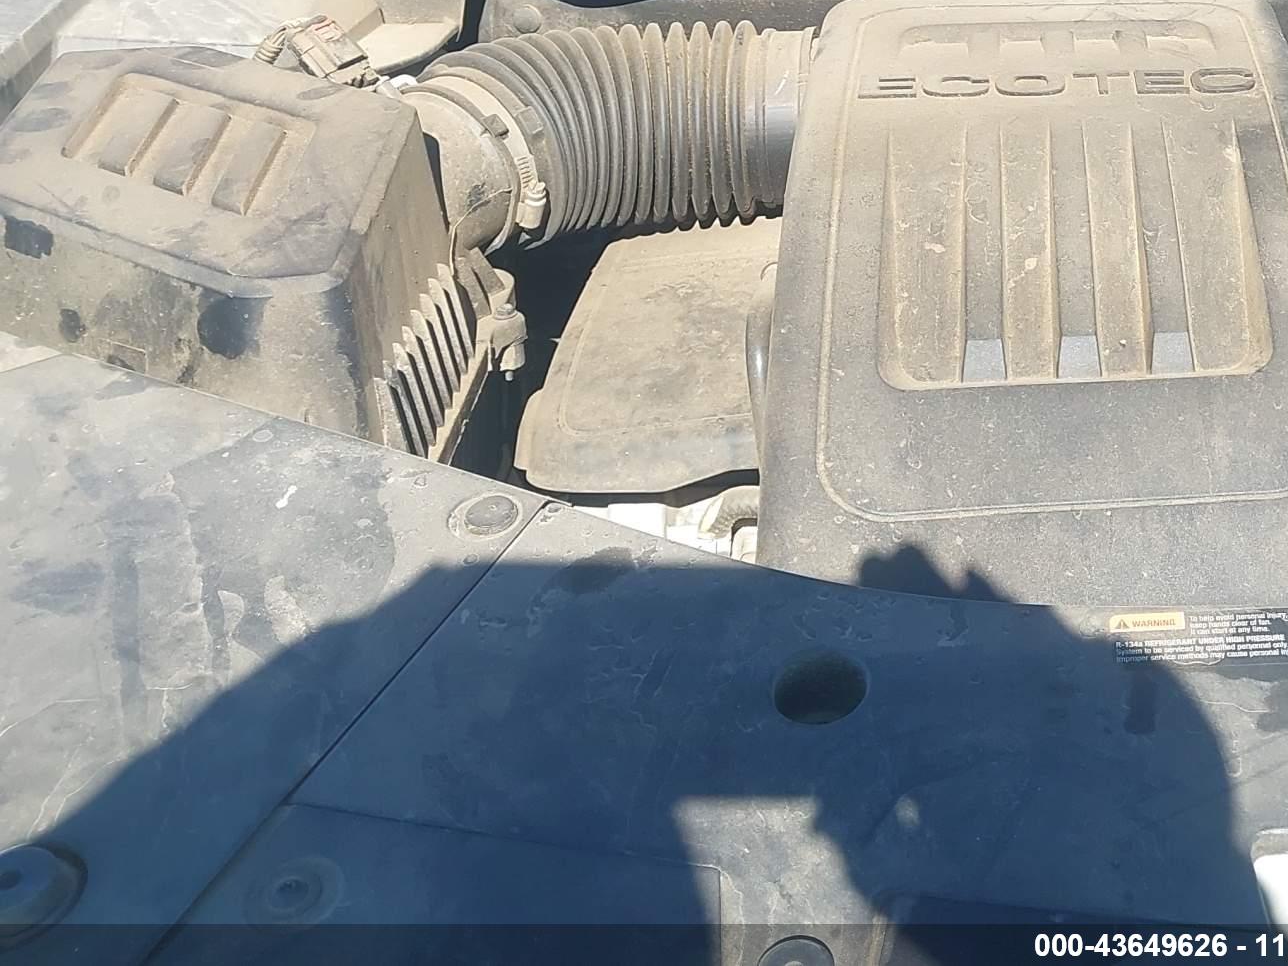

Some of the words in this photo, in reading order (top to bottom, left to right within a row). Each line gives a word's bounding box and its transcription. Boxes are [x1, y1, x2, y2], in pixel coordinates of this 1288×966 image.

[857, 67, 1257, 100] ECOTEC
[1132, 619, 1176, 627] WARNING
[1144, 638, 1196, 647] REFRIGERANT
[1246, 634, 1285, 642] PRESSURE
[1237, 642, 1271, 650] personnel
[1249, 650, 1279, 658] personal
